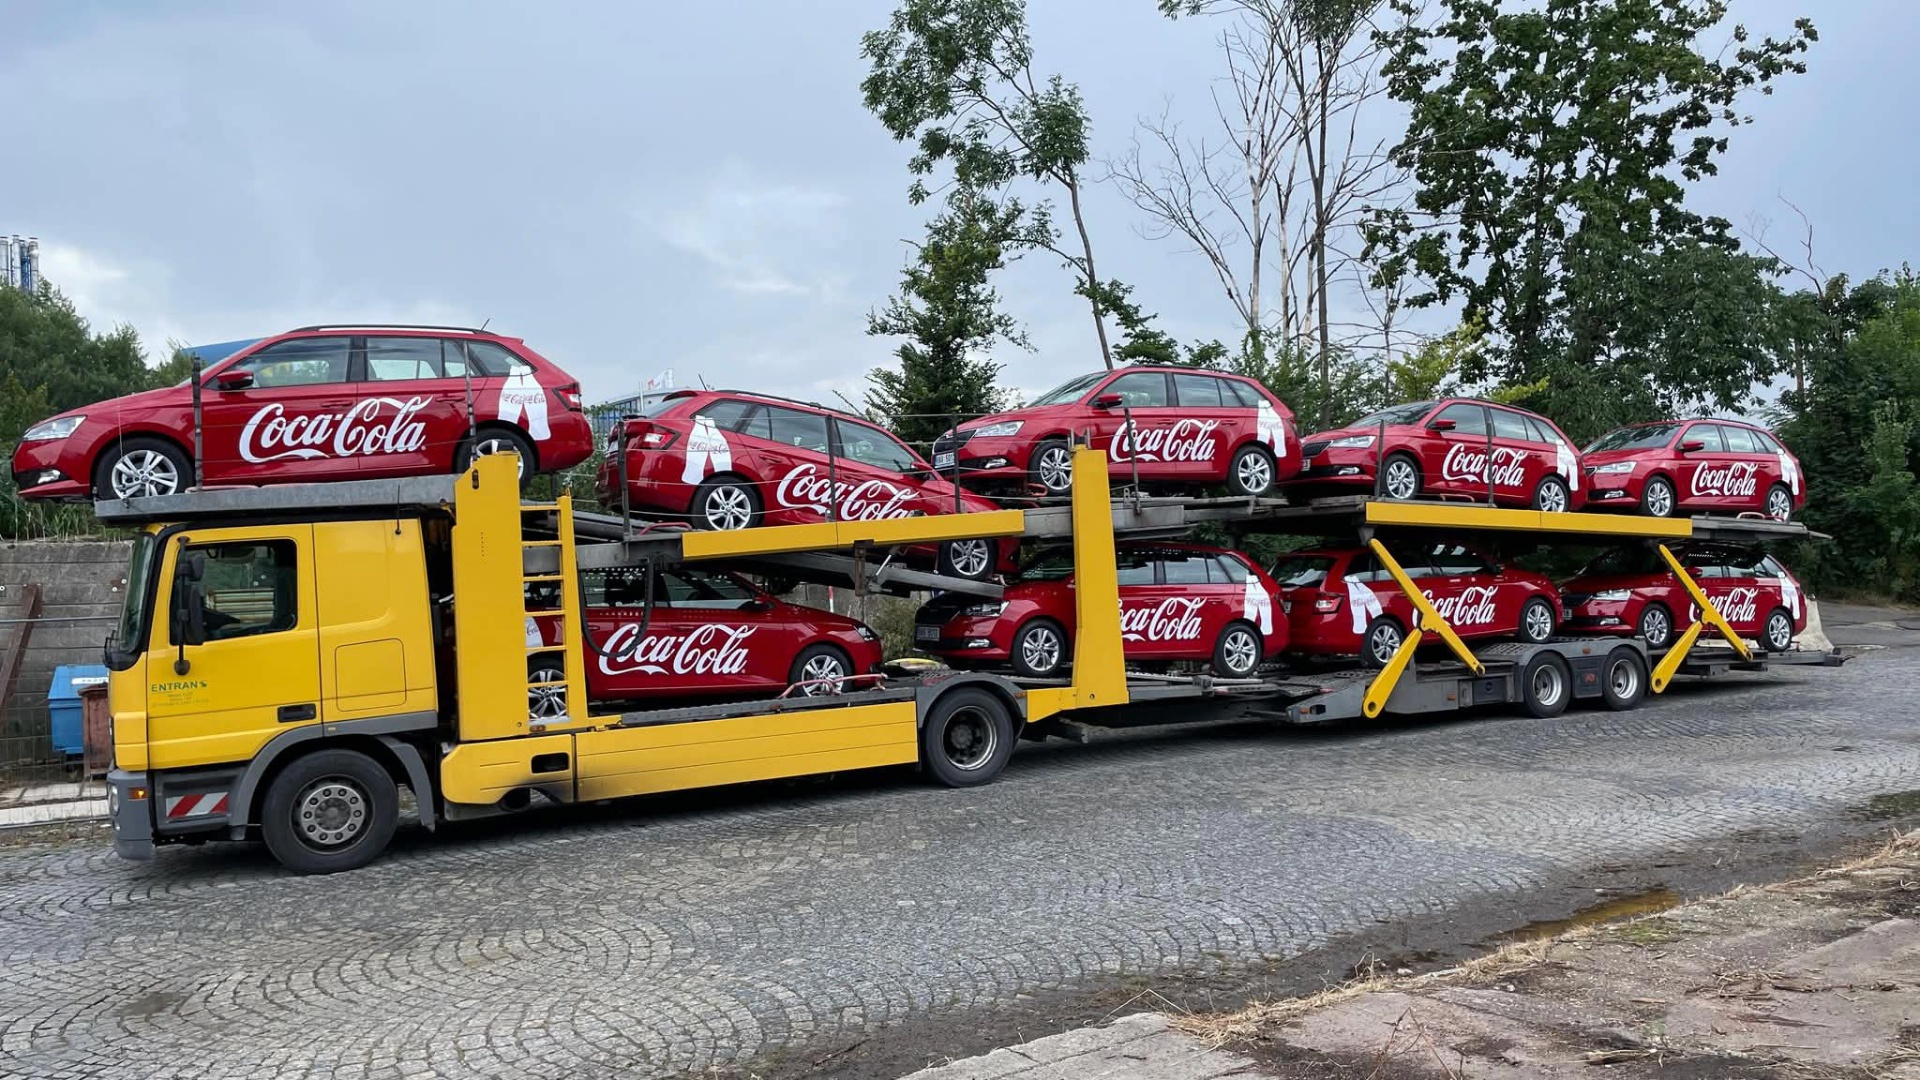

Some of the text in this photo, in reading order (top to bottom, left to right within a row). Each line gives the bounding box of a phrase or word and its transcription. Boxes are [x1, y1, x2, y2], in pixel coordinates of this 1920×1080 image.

[239, 395, 433, 463] Coca-Cola
[1110, 418, 1220, 462] Coca-Cola
[1442, 443, 1529, 486] Coca-Cola
[1691, 461, 1758, 496] Coca-Cola
[1118, 597, 1207, 642] ca-Cola
[1689, 587, 1759, 622] ca-Cola
[599, 623, 758, 675] Coca-Cola
